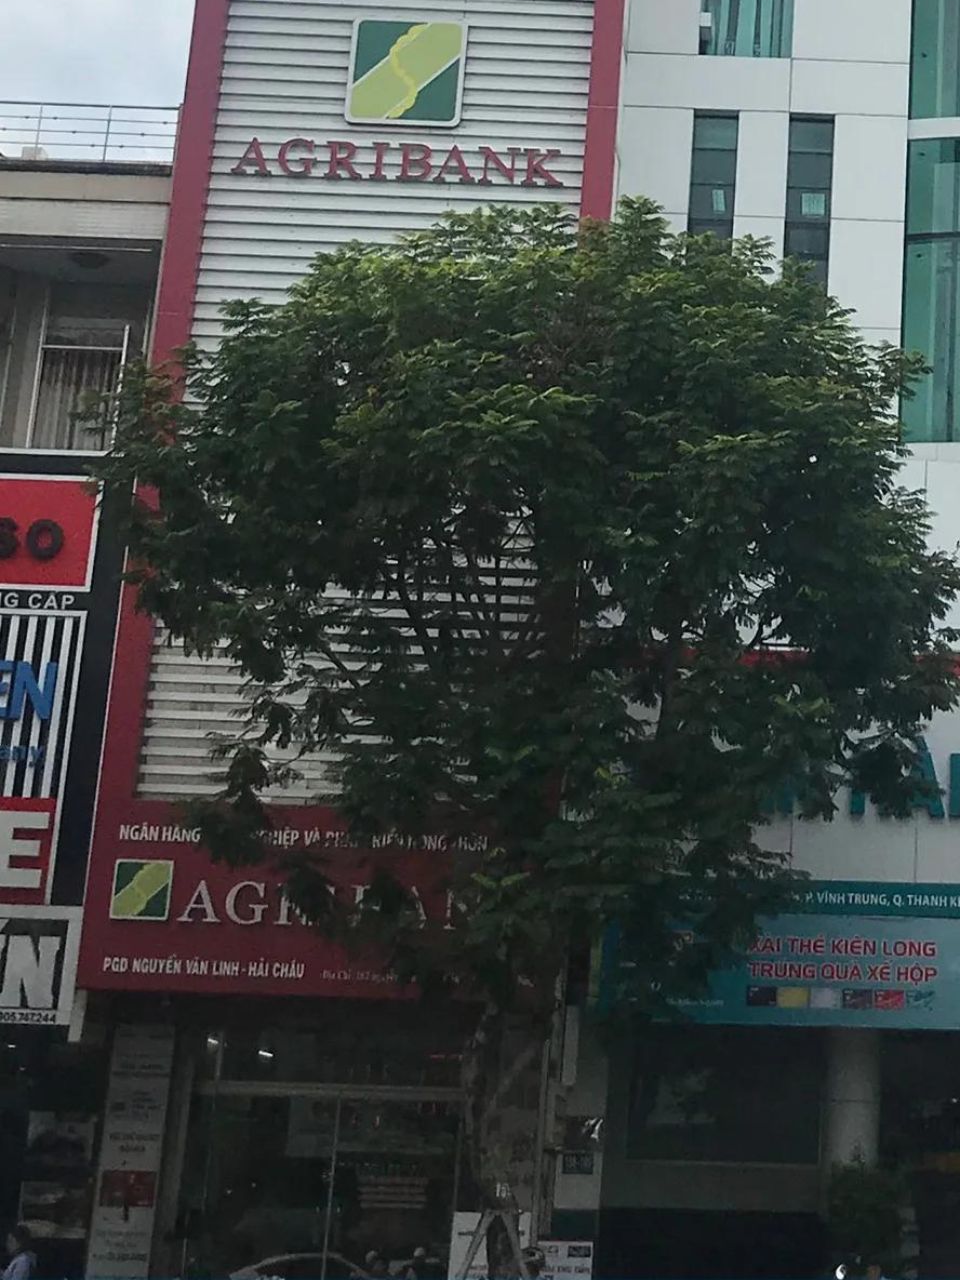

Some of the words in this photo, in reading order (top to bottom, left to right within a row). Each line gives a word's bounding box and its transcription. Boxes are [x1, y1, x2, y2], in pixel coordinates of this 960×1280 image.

[231, 137, 565, 188] AGRIBANK
[118, 823, 158, 842] NGÂN
[892, 894, 905, 907] Q.
[906, 895, 947, 907] THANH
[830, 935, 877, 955] KIÊN
[881, 939, 937, 958] LONG
[102, 957, 128, 973] PGD
[211, 961, 237, 976] LINH
